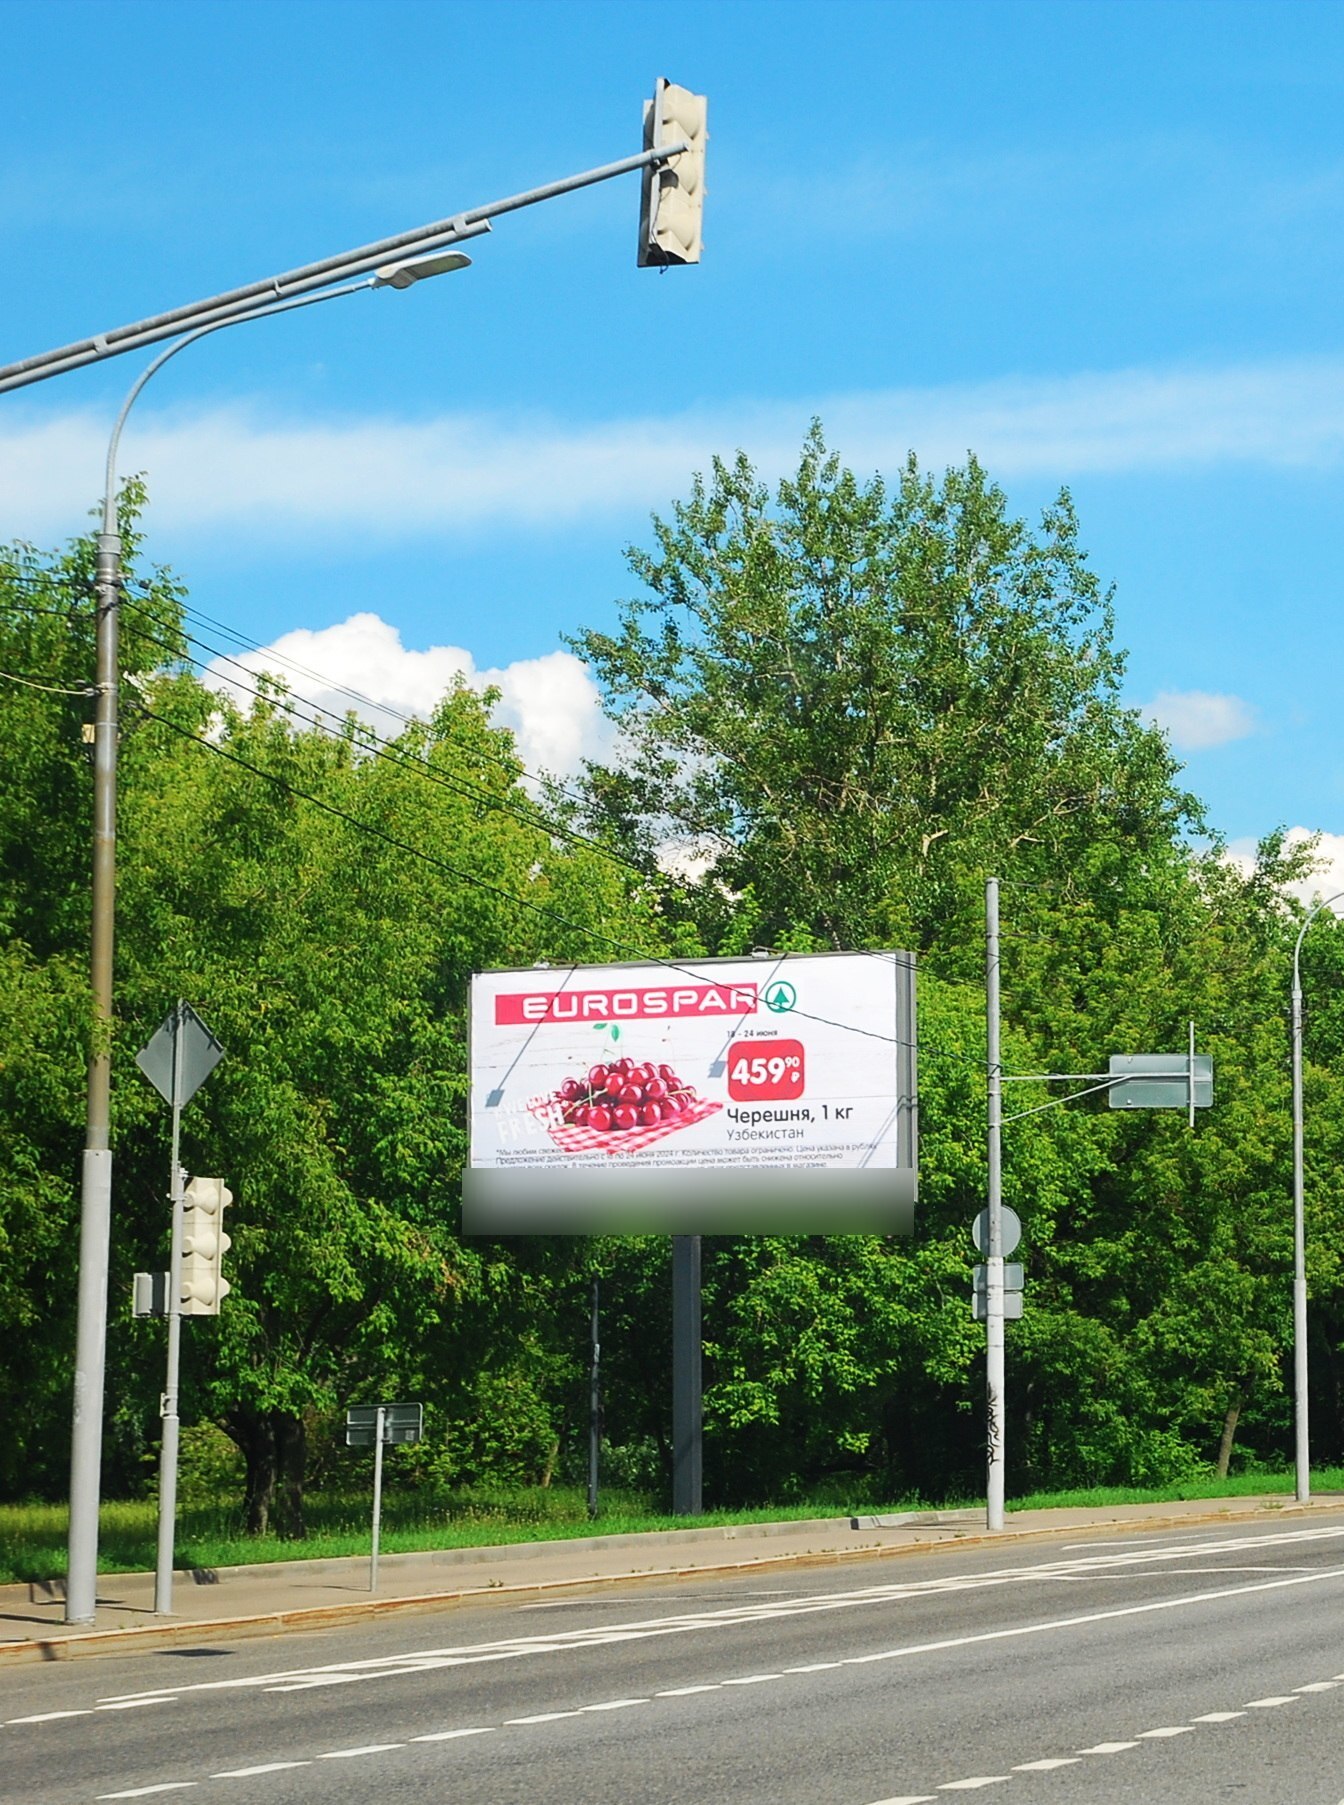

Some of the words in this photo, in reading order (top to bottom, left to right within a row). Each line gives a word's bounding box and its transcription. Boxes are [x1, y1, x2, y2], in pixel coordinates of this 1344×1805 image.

[523, 988, 756, 1019] EUROSPAR
[744, 1030, 754, 1038] 24
[731, 1057, 786, 1085] 459
[785, 1056, 800, 1068] 90
[727, 1107, 815, 1127] Черешня,
[822, 1104, 829, 1120] 1
[835, 1107, 853, 1120] кг
[727, 1128, 804, 1141] Узбекистан
